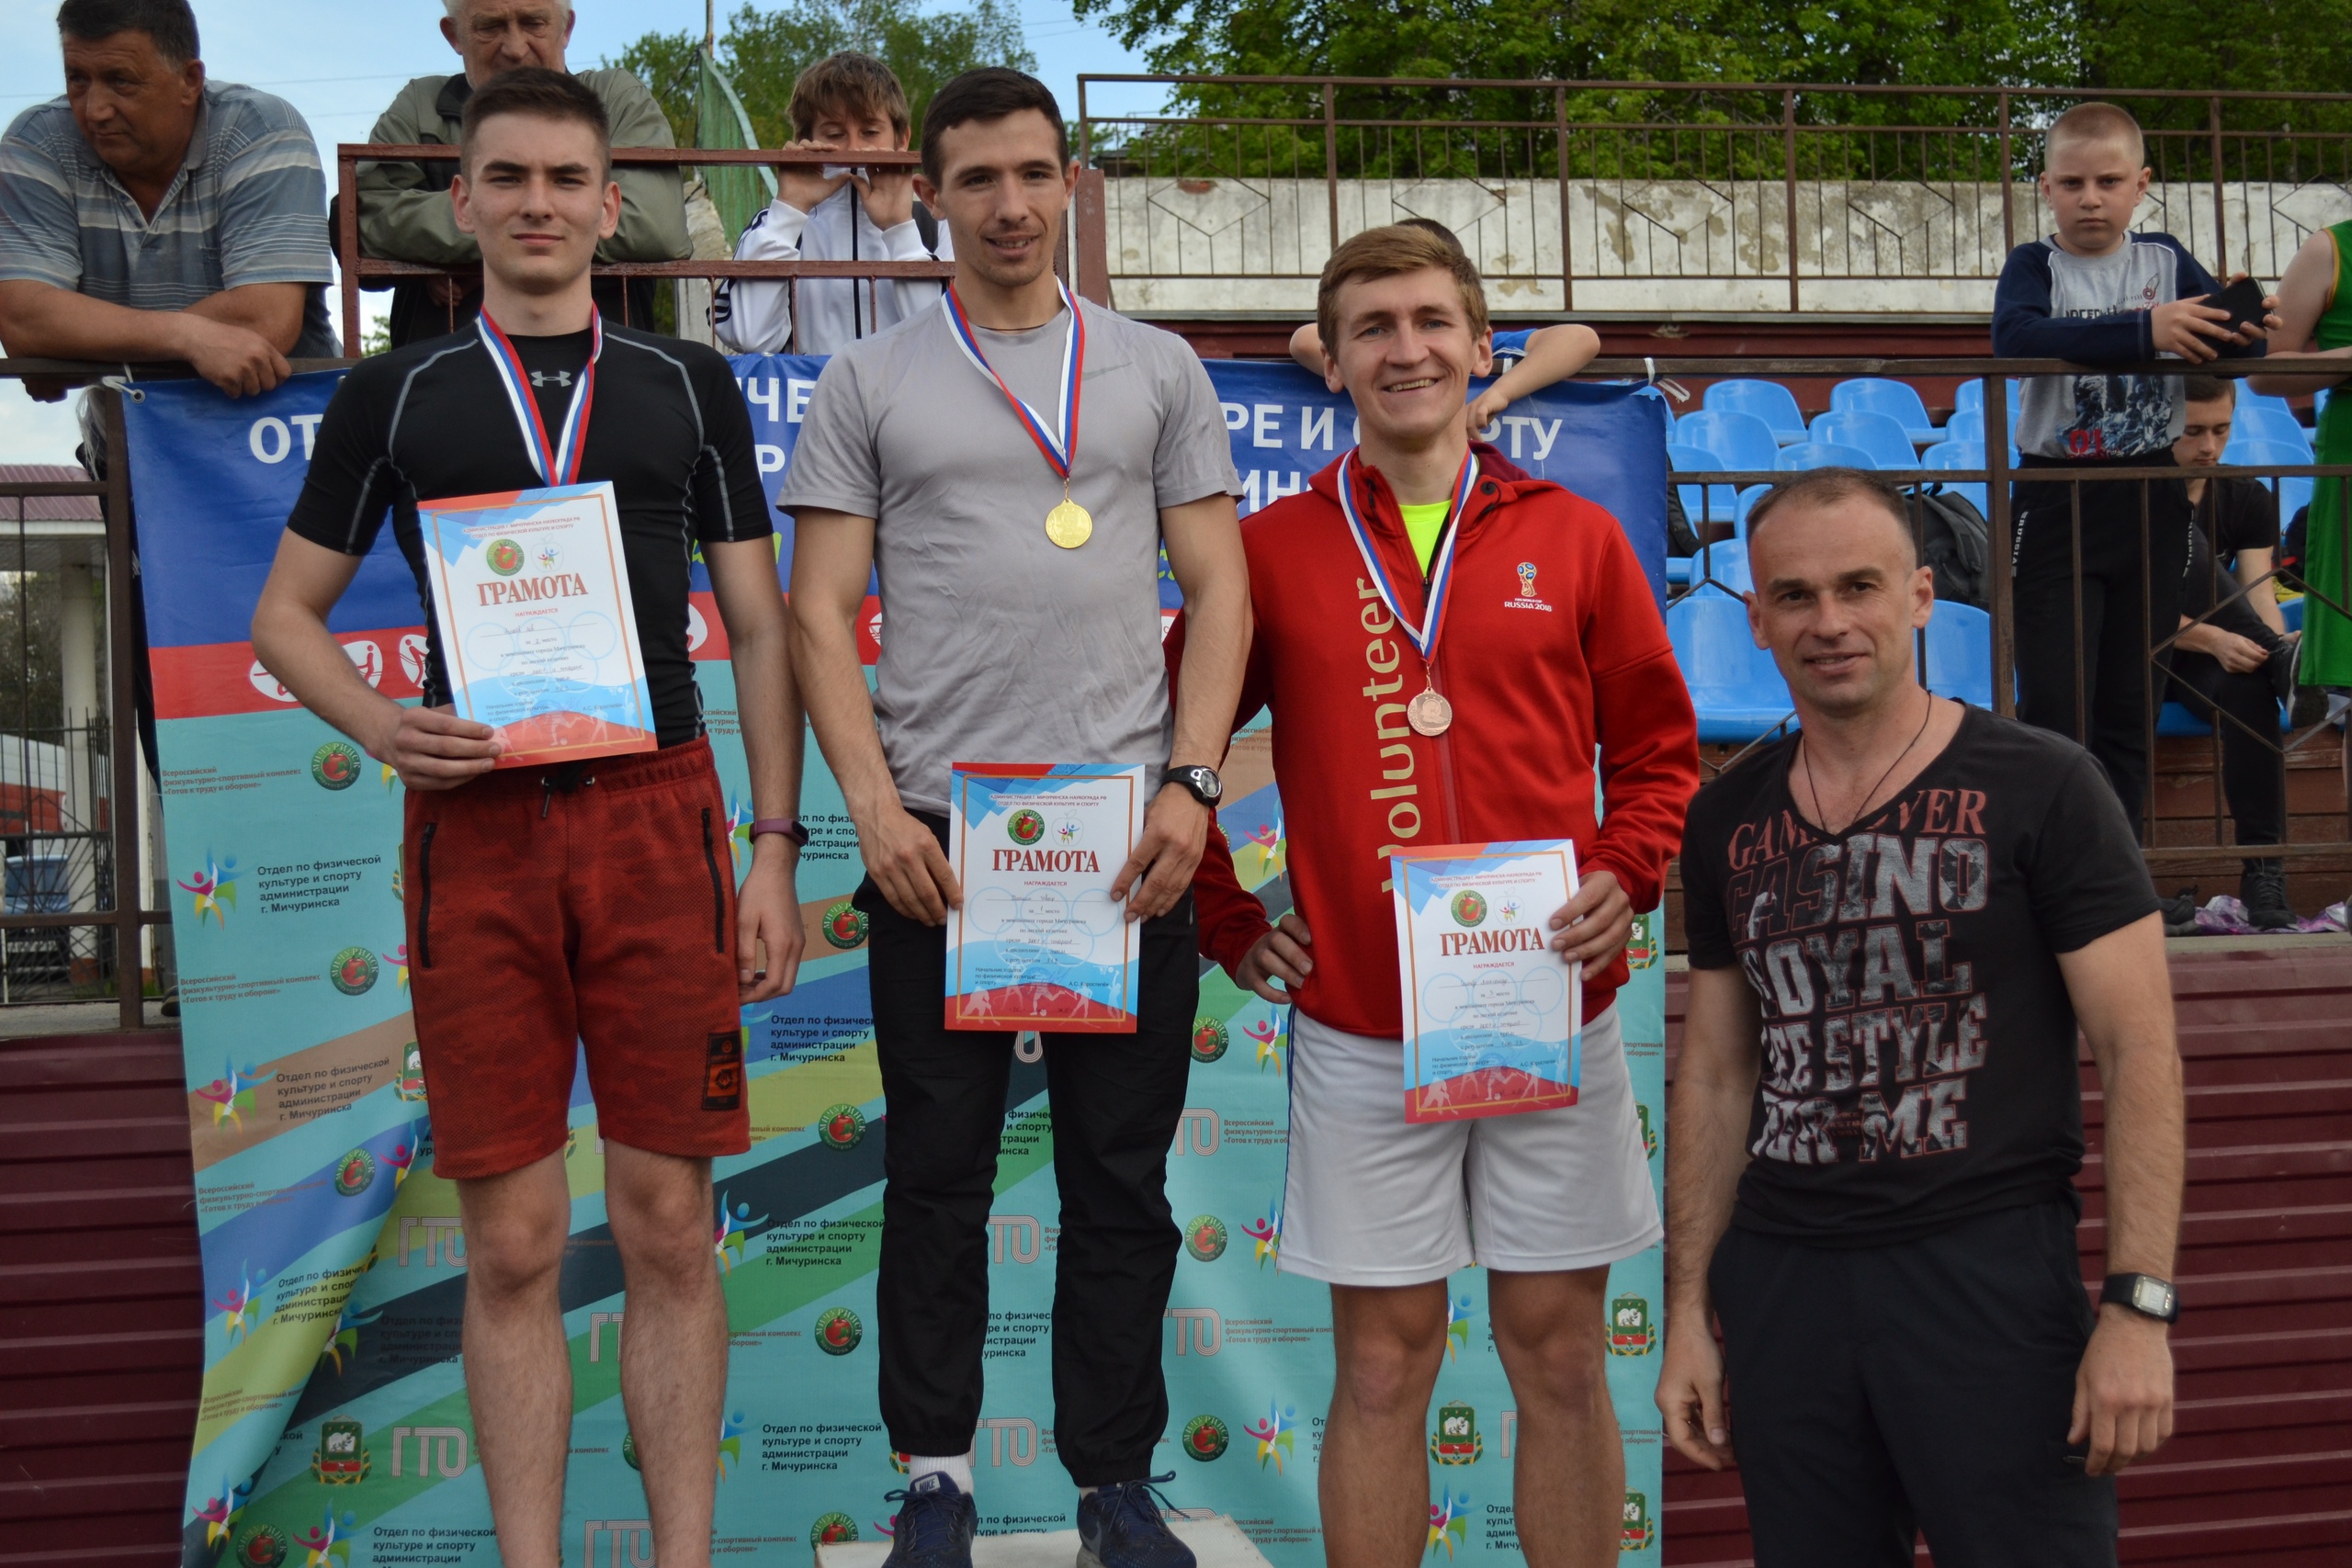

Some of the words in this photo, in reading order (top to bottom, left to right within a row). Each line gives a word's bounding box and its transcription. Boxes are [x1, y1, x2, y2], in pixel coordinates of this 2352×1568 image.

[1301, 406, 1334, 450] И
[496, 527, 527, 536] ФИЗИЧЕСКОЙ
[477, 572, 588, 606] ГРАМОТА
[515, 607, 559, 617] НАГРАЖДАЕТСЯ
[1534, 604, 1552, 612] 2018
[1356, 578, 1421, 889] olunteer
[312, 742, 361, 773] МИЧУРИНСК
[162, 766, 217, 777] Всероссийский
[163, 771, 266, 786] физкультурно-спортивный
[266, 768, 302, 778] комплекс
[164, 786, 188, 795] «Готов
[195, 785, 217, 796] труду
[224, 782, 262, 792] обороне»
[1008, 809, 1045, 829] МИЧУРИНСК
[1727, 809, 1819, 871] GAM
[257, 863, 294, 876] Отдел
[296, 863, 311, 872] по
[312, 854, 381, 871] физической
[992, 849, 1101, 873] ГРАМОТА
[258, 874, 311, 889] культуре
[322, 870, 362, 884] спорту
[259, 885, 350, 902] администрации
[1726, 832, 1987, 944] CASINO
[261, 906, 268, 914] г.
[271, 897, 340, 915] Мичуринска
[1440, 928, 1545, 956] ГРАМОТА
[331, 947, 379, 980] МИЧУРИНСК
[180, 974, 237, 986] Всероссийский
[181, 977, 285, 996] физкультурно-спортивный
[285, 974, 321, 985] комплекс
[183, 994, 208, 1004] «Готов
[213, 992, 236, 1003] труду
[244, 988, 281, 998] обороне»
[772, 1015, 804, 1025] Отдел
[771, 1029, 819, 1038] культуре
[831, 1030, 869, 1039] спорту
[1823, 993, 1987, 1091] STYLE
[771, 1042, 856, 1050] администрации
[780, 1053, 845, 1064] Мичуринска
[277, 1071, 311, 1083] Отдел
[314, 1069, 329, 1078] по
[331, 1057, 390, 1077] физической
[277, 1081, 327, 1097] культуре
[338, 1074, 373, 1089] спорту
[278, 1089, 361, 1109] администрации
[279, 1112, 287, 1121] г.
[289, 1102, 352, 1121] Мичуринска
[819, 1104, 865, 1133] МИЧУРИНСК
[1858, 1077, 1968, 1163] ME
[334, 1148, 375, 1180] МИЧУРИНСК
[198, 1182, 254, 1194] Всероссийский
[200, 1202, 226, 1214] «Готов
[233, 1200, 255, 1212] труду
[767, 1219, 800, 1228] Отдел
[820, 1218, 885, 1230] физической
[1185, 1215, 1227, 1243] МИЧУРИНСК
[399, 1216, 468, 1267] ГТО
[766, 1232, 815, 1242] культуре
[828, 1233, 865, 1242] спорту
[766, 1245, 852, 1254] администрации
[766, 1258, 773, 1266] г.
[775, 1257, 842, 1267] Мичуринска
[278, 1275, 304, 1288] Отдел
[307, 1272, 319, 1280] по
[277, 1285, 317, 1302] культуре
[815, 1308, 863, 1337] МИЧУРИНСК
[1012, 1325, 1049, 1334] спорту
[1225, 1318, 1272, 1326] Всероссийский
[1226, 1326, 1314, 1336] физкультурно-спортивный
[246, 1403, 283, 1411] обороне»
[763, 1424, 797, 1434] Отдел
[816, 1423, 882, 1434] физической
[1183, 1415, 1229, 1442] МИЧУРИНСК
[763, 1438, 811, 1447] культуре
[824, 1437, 862, 1446] спорту
[391, 1427, 468, 1477] ГТО
[763, 1450, 848, 1459] администрации
[772, 1461, 838, 1472] Мичуринска
[919, 1478, 935, 1492] NIKE
[1002, 1513, 1066, 1526] физической
[374, 1527, 408, 1538] Отдел
[429, 1527, 496, 1539] физической
[373, 1542, 423, 1551] культуре
[436, 1542, 476, 1552] спорту
